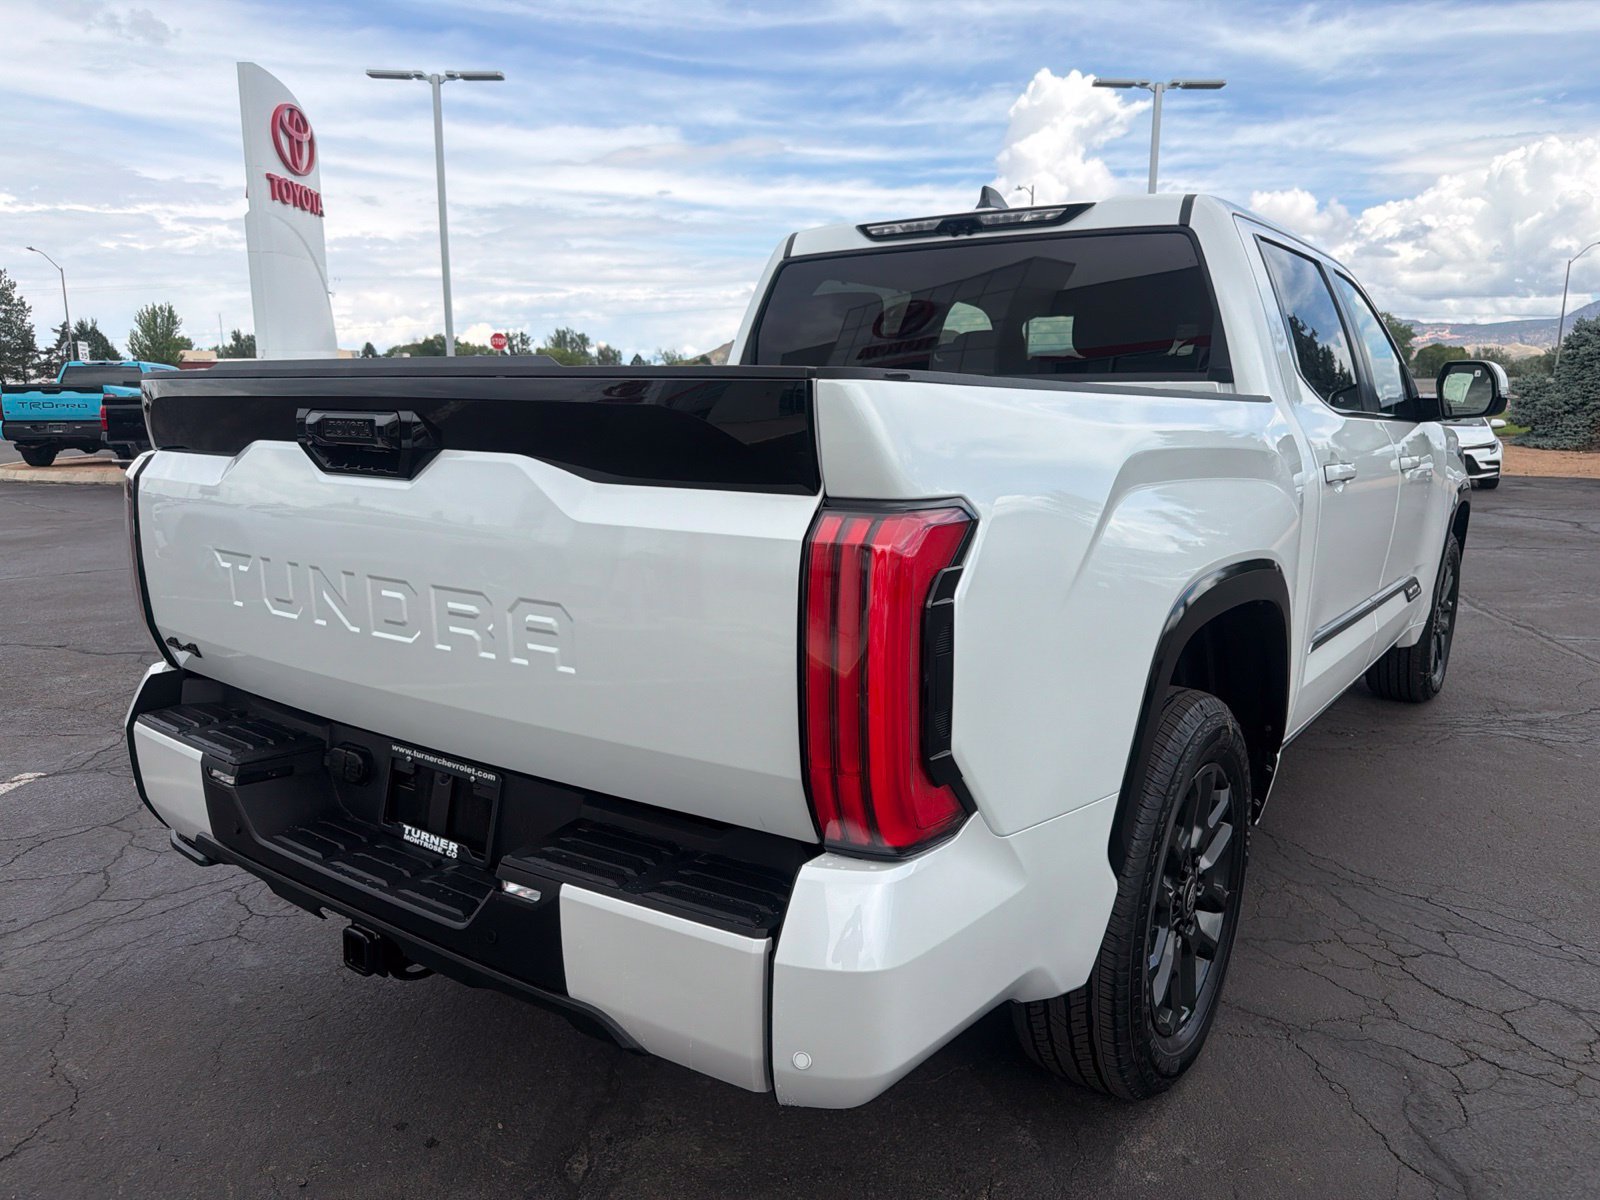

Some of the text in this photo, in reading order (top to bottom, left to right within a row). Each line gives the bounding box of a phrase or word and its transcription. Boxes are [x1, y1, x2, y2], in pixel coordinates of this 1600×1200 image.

[265, 173, 325, 217] TOYOTA
[491, 337, 506, 346] STOP
[213, 548, 577, 675] TUNDRA
[391, 744, 496, 781] www.turnerchevrolet.com
[402, 824, 459, 853] TURNER
[446, 850, 458, 859] CO
